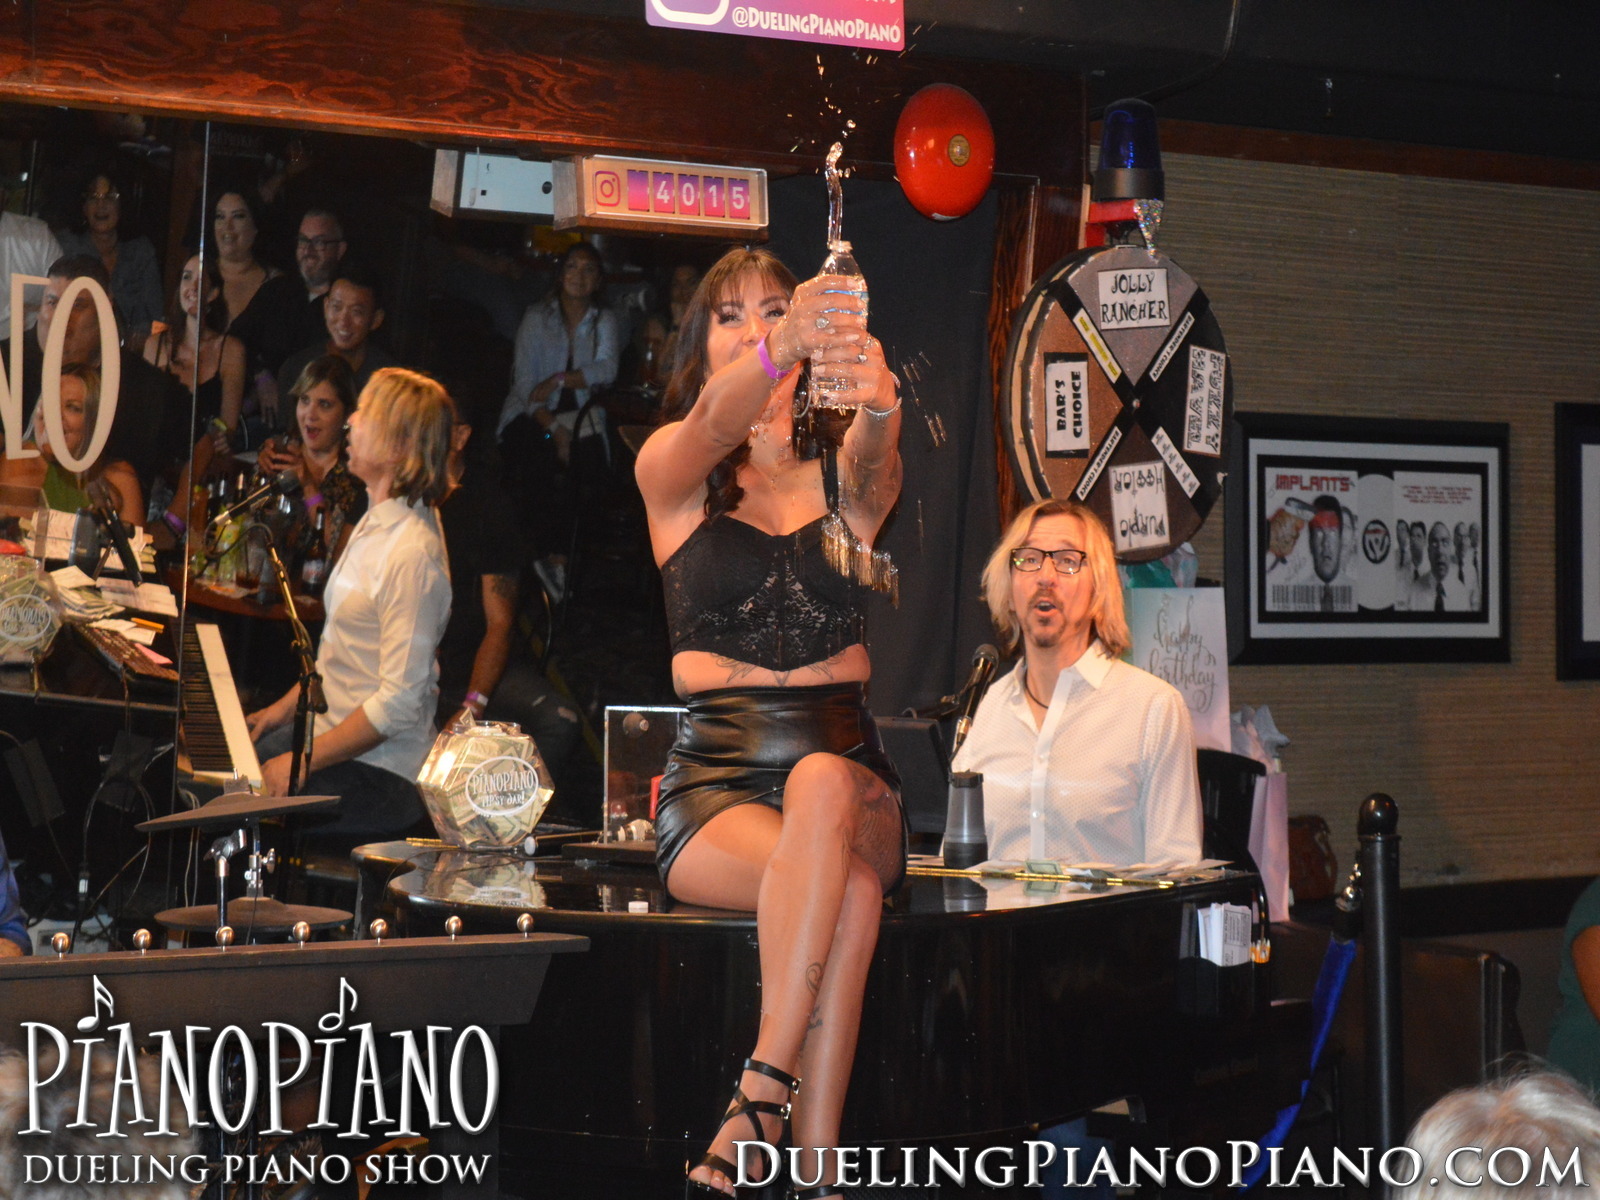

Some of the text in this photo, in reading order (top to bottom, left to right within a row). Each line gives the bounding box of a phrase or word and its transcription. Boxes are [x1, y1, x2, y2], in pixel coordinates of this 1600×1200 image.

[656, 180, 745, 210] 4015
[1110, 273, 1155, 296] JOLLY
[1100, 300, 1170, 324] RANCHER
[1056, 379, 1066, 431] BAR'S
[1072, 370, 1082, 438] CHOICE
[1275, 474, 1350, 492] IMPLANTS
[472, 766, 534, 794] PIANOPIANO
